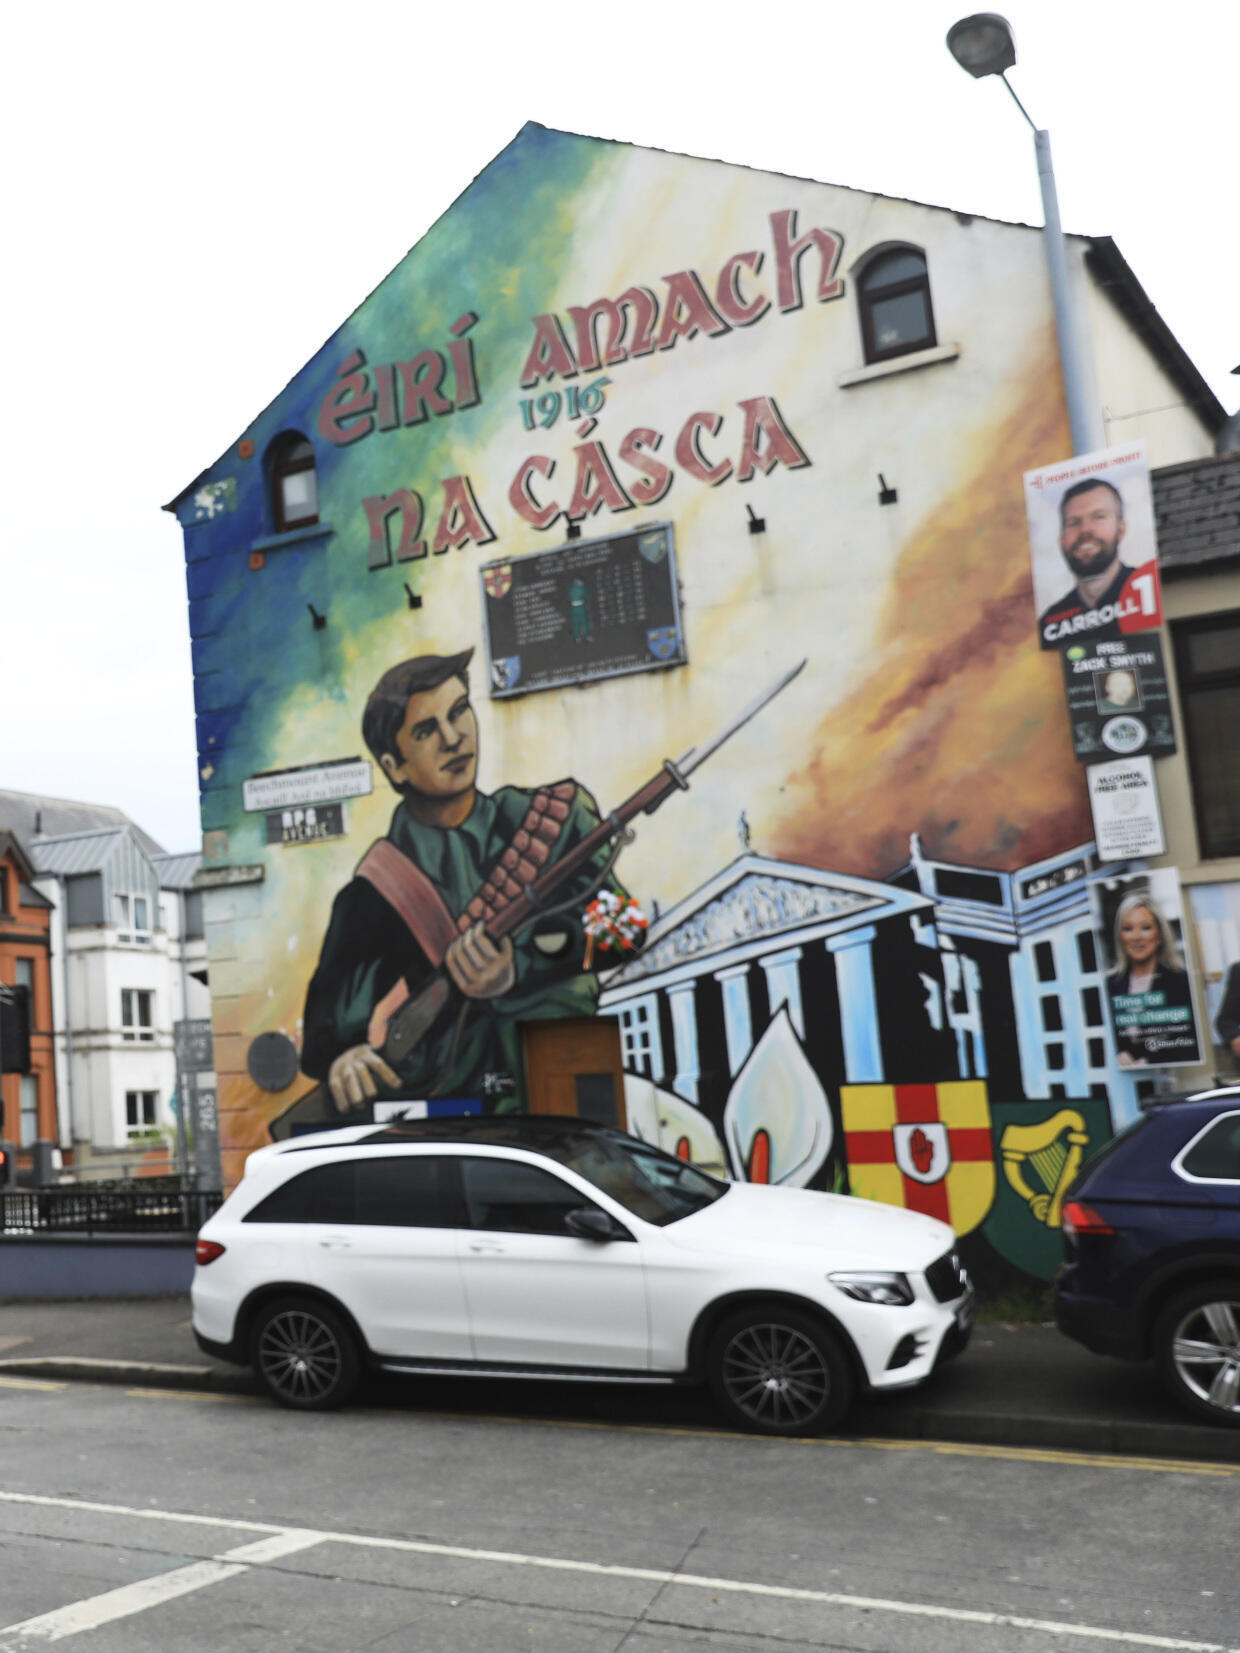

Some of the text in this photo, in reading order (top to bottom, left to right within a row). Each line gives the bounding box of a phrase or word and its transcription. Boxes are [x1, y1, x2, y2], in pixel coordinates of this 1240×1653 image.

[518, 376, 612, 431] 1916
[508, 396, 813, 531] CÁSCA
[1130, 573, 1157, 617] 1
[1043, 597, 1141, 642] CARROLL
[1096, 771, 1144, 785] ALCOHOL
